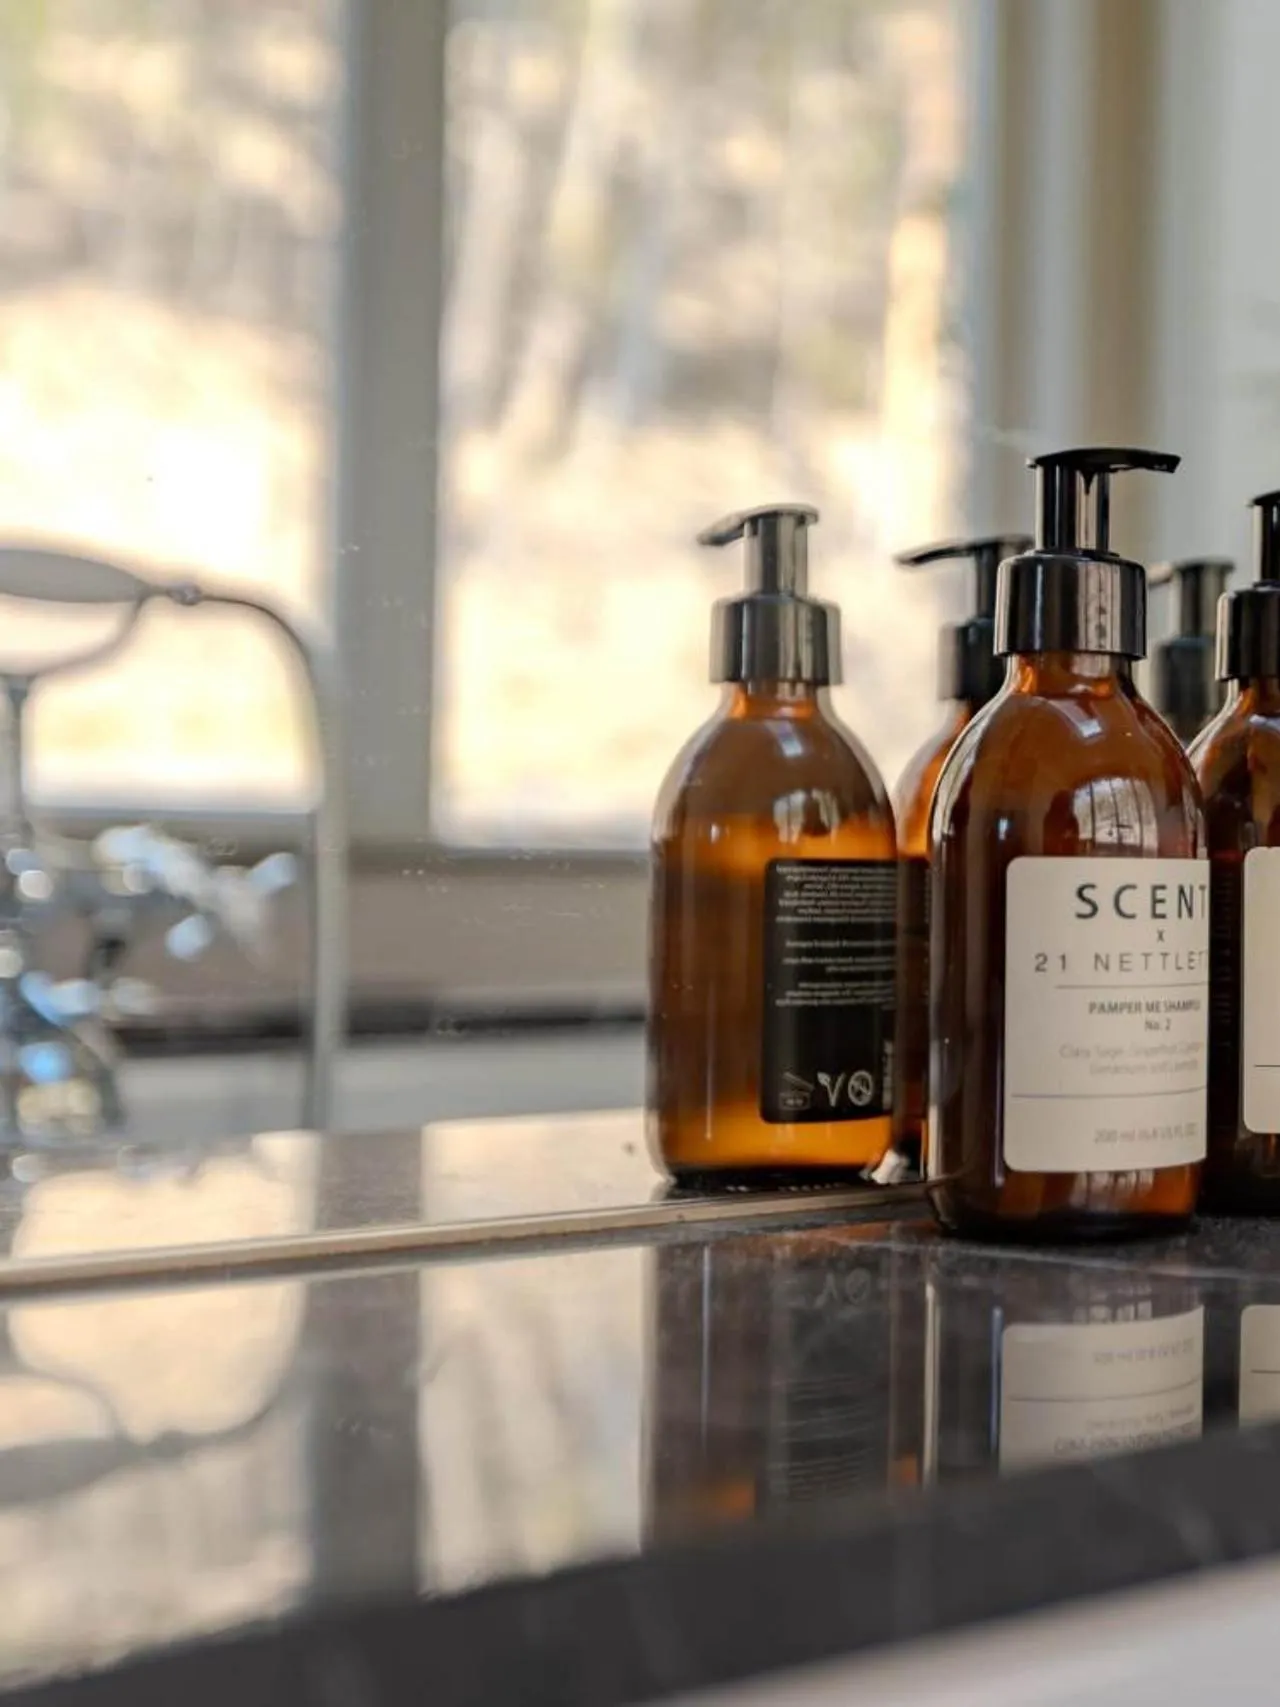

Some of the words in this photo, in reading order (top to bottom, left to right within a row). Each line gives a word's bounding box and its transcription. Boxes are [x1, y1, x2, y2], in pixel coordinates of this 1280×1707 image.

[1075, 883, 1207, 920] SCENT
[1034, 952, 1067, 973] 21
[1088, 1001, 1142, 1014] PAMPER
[1145, 1001, 1163, 1014] ME
